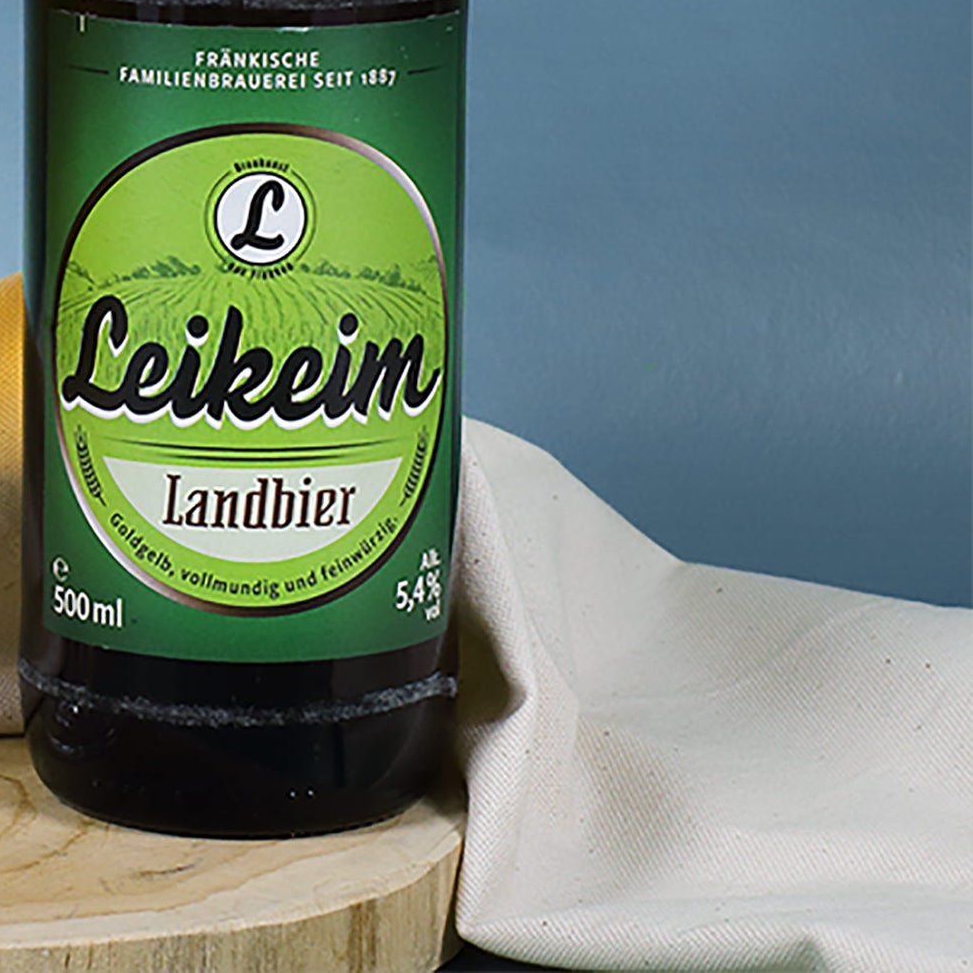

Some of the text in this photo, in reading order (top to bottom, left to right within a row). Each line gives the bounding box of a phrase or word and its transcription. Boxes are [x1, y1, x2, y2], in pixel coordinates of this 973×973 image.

[119, 66, 396, 90] FAMILIENBRAUEREI SEIT 1887
[194, 47, 320, 68] FRÄNKISCHE
[230, 179, 285, 251] L
[61, 294, 441, 429] Leikeim
[163, 474, 356, 529] Landbier
[110, 513, 175, 576] Goldgelb,
[181, 568, 280, 600] vollmundig
[284, 571, 318, 594] und
